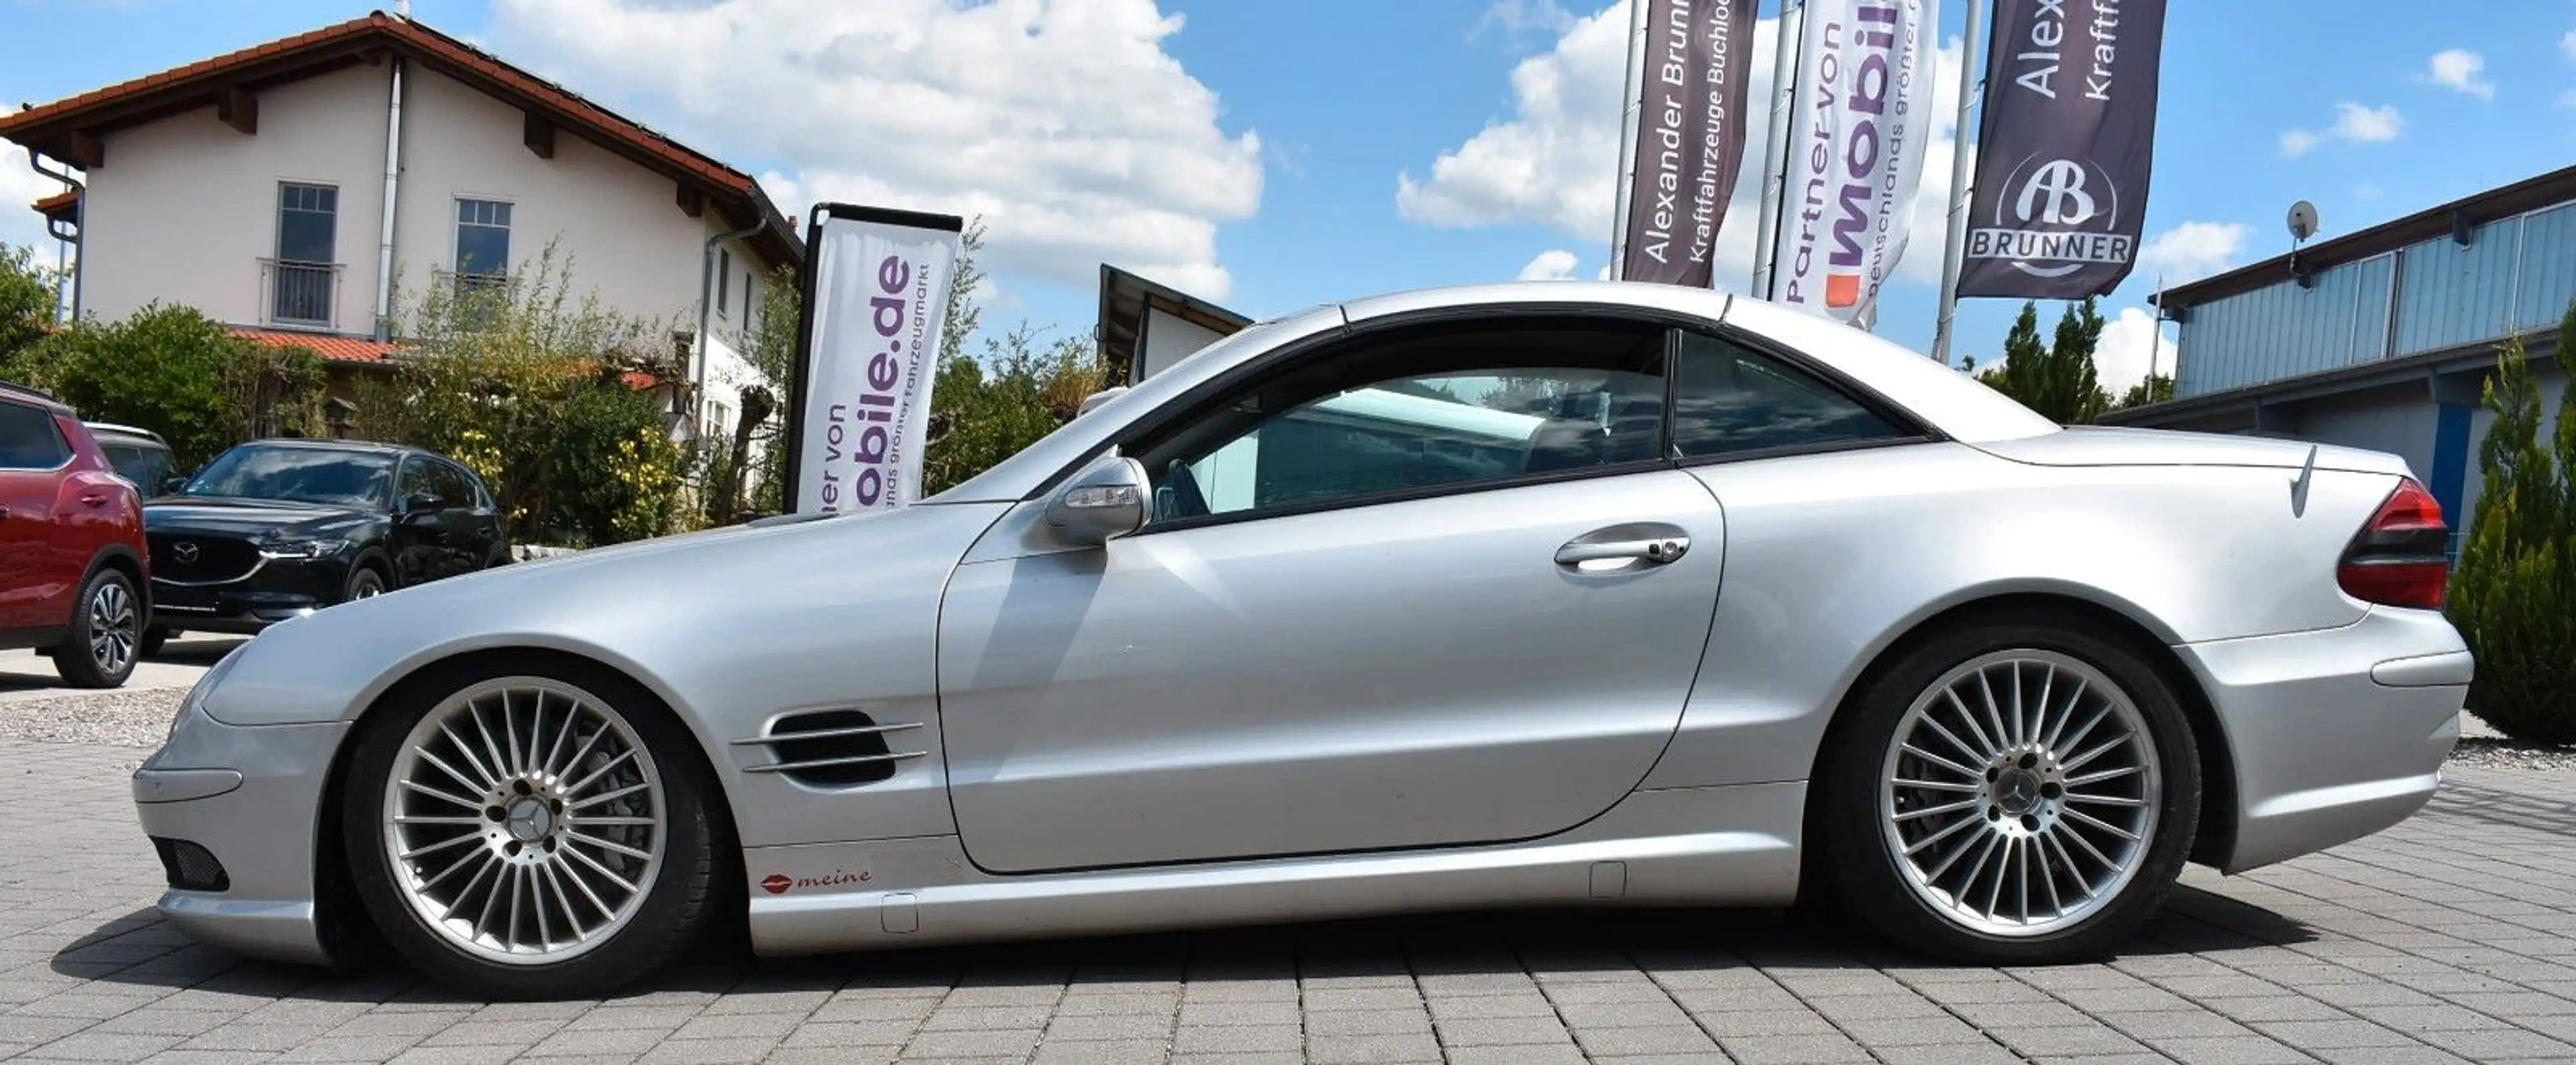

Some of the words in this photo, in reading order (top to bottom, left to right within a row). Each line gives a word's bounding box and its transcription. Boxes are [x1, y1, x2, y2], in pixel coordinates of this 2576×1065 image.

[2085, 0, 2120, 101] Kraftf
[1645, 95, 1682, 264] Alexander
[1690, 90, 1725, 263] Kraftfahrzeuge
[1786, 122, 1831, 304] Partner
[1817, 21, 1841, 110] von
[1829, 6, 1897, 266] mobil
[1972, 231, 2128, 262] BRUNNER
[904, 264, 930, 397] Fahrzeugmarkt
[825, 404, 847, 463] von
